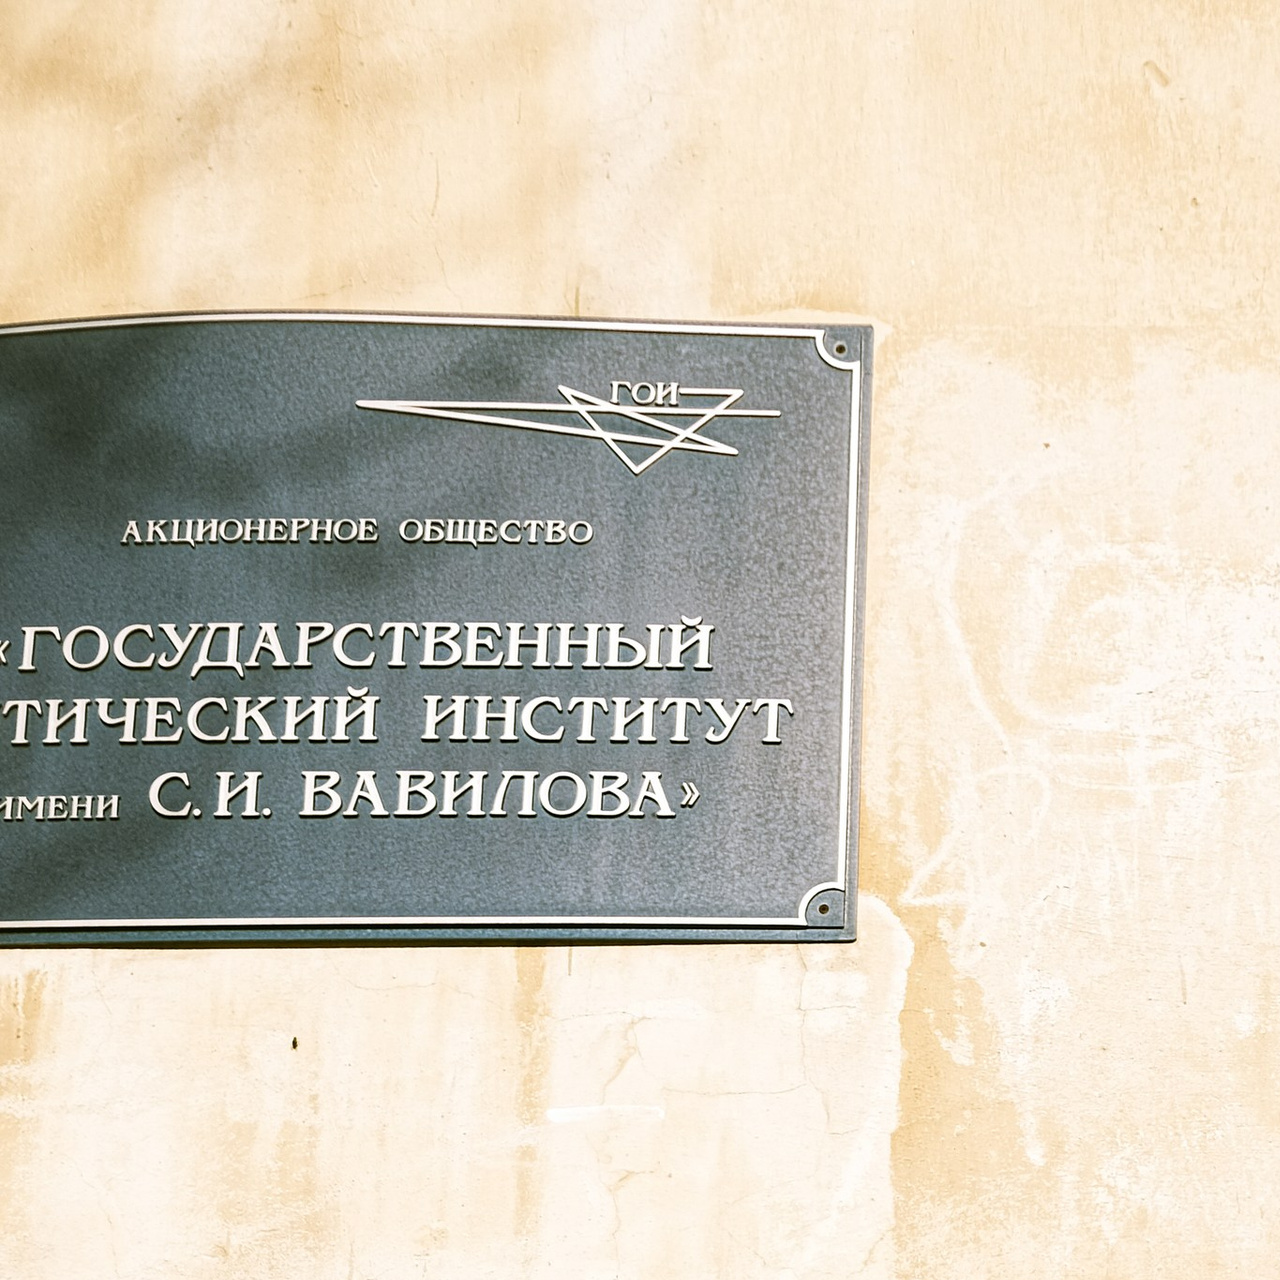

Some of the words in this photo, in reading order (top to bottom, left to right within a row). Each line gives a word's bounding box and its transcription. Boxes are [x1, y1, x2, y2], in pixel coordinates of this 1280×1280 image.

[609, 380, 679, 406] ГОИ
[121, 518, 379, 548] АКЦИОНЕРНОЕ
[399, 518, 594, 549] ОБЩЕСТВО
[2, 686, 381, 745] ТИЧЕСКИЙ
[420, 694, 795, 745] ИНСТИТУТ
